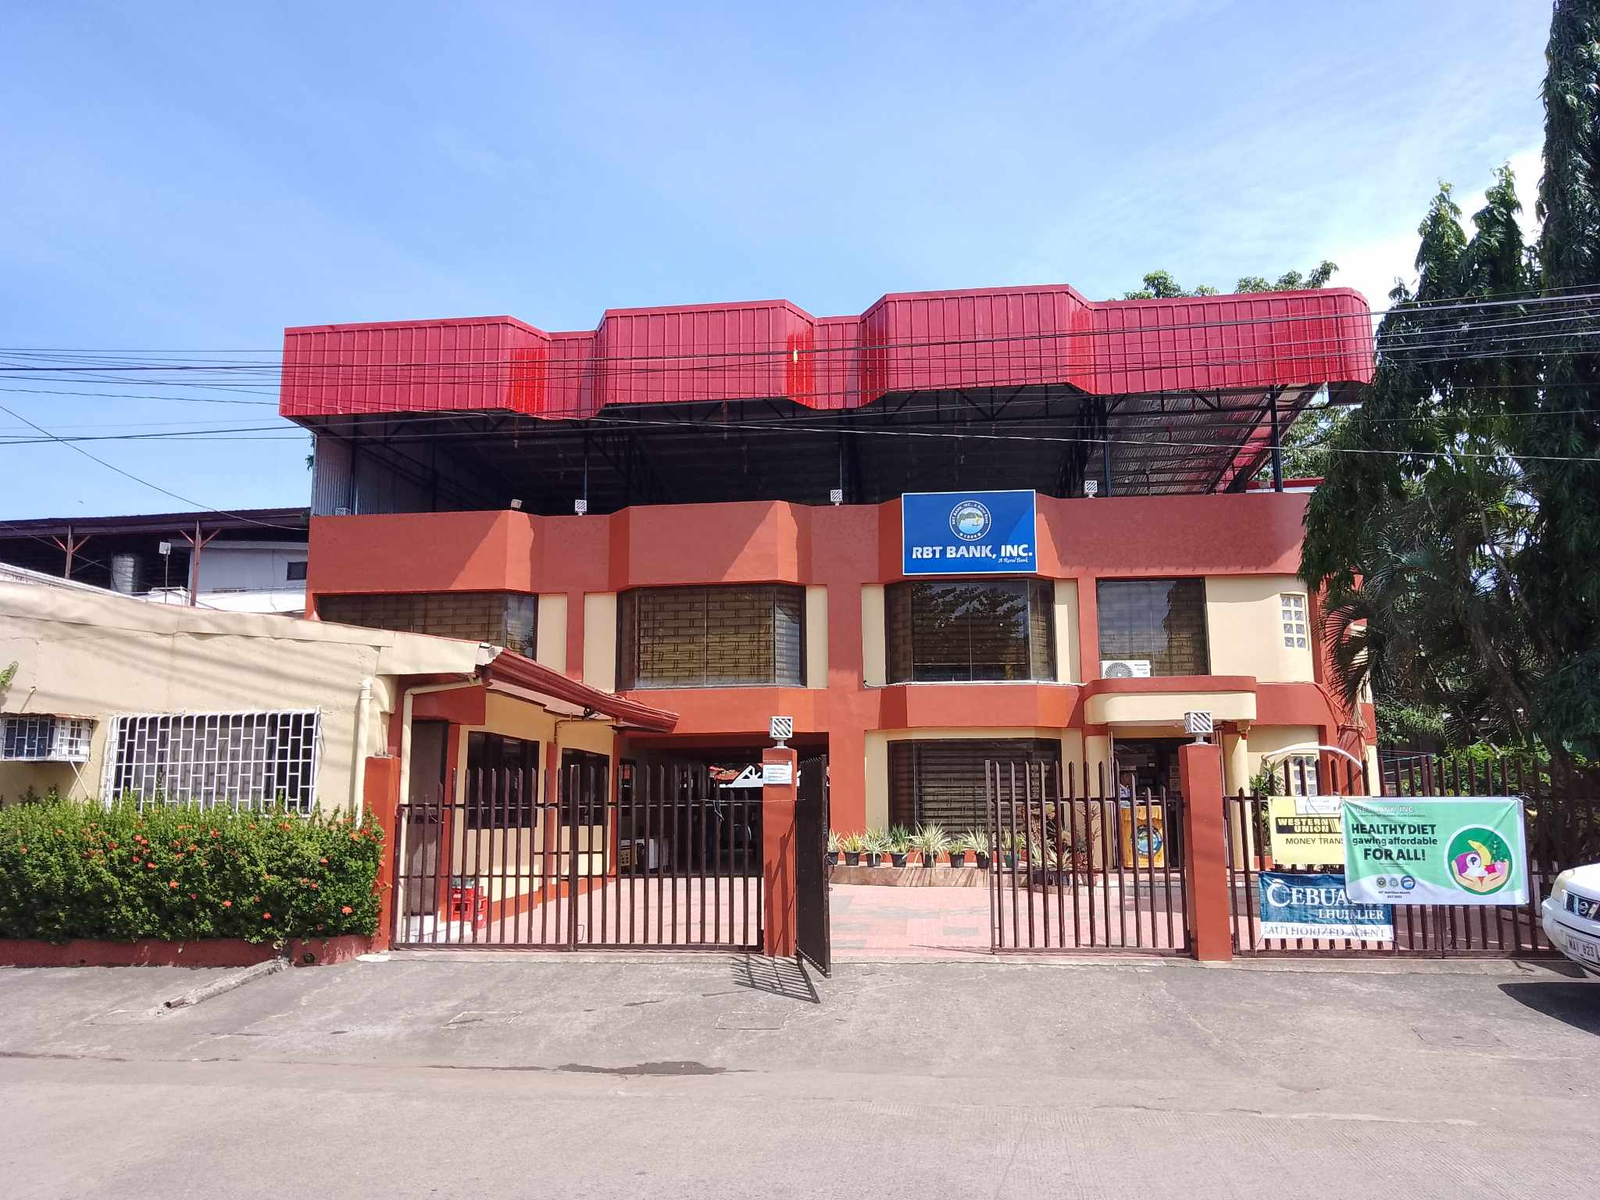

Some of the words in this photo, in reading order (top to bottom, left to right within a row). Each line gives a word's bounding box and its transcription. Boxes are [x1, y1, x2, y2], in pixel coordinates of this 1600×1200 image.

[912, 546, 943, 559] RBT
[946, 545, 997, 560] BANK,
[1000, 544, 1033, 557] INC.
[1277, 818, 1329, 826] WESTERN
[1294, 825, 1330, 833] UNION
[1351, 823, 1407, 835] HEALTHY
[1408, 824, 1437, 835] DIET
[1286, 837, 1316, 845] MONEY
[1352, 836, 1387, 847] gawing
[1388, 836, 1438, 846] affordable
[1363, 848, 1395, 861] FOR
[1396, 848, 1426, 862] ALL!
[1267, 924, 1345, 937] AUTHORIZED
[1347, 925, 1386, 938] AGENT
